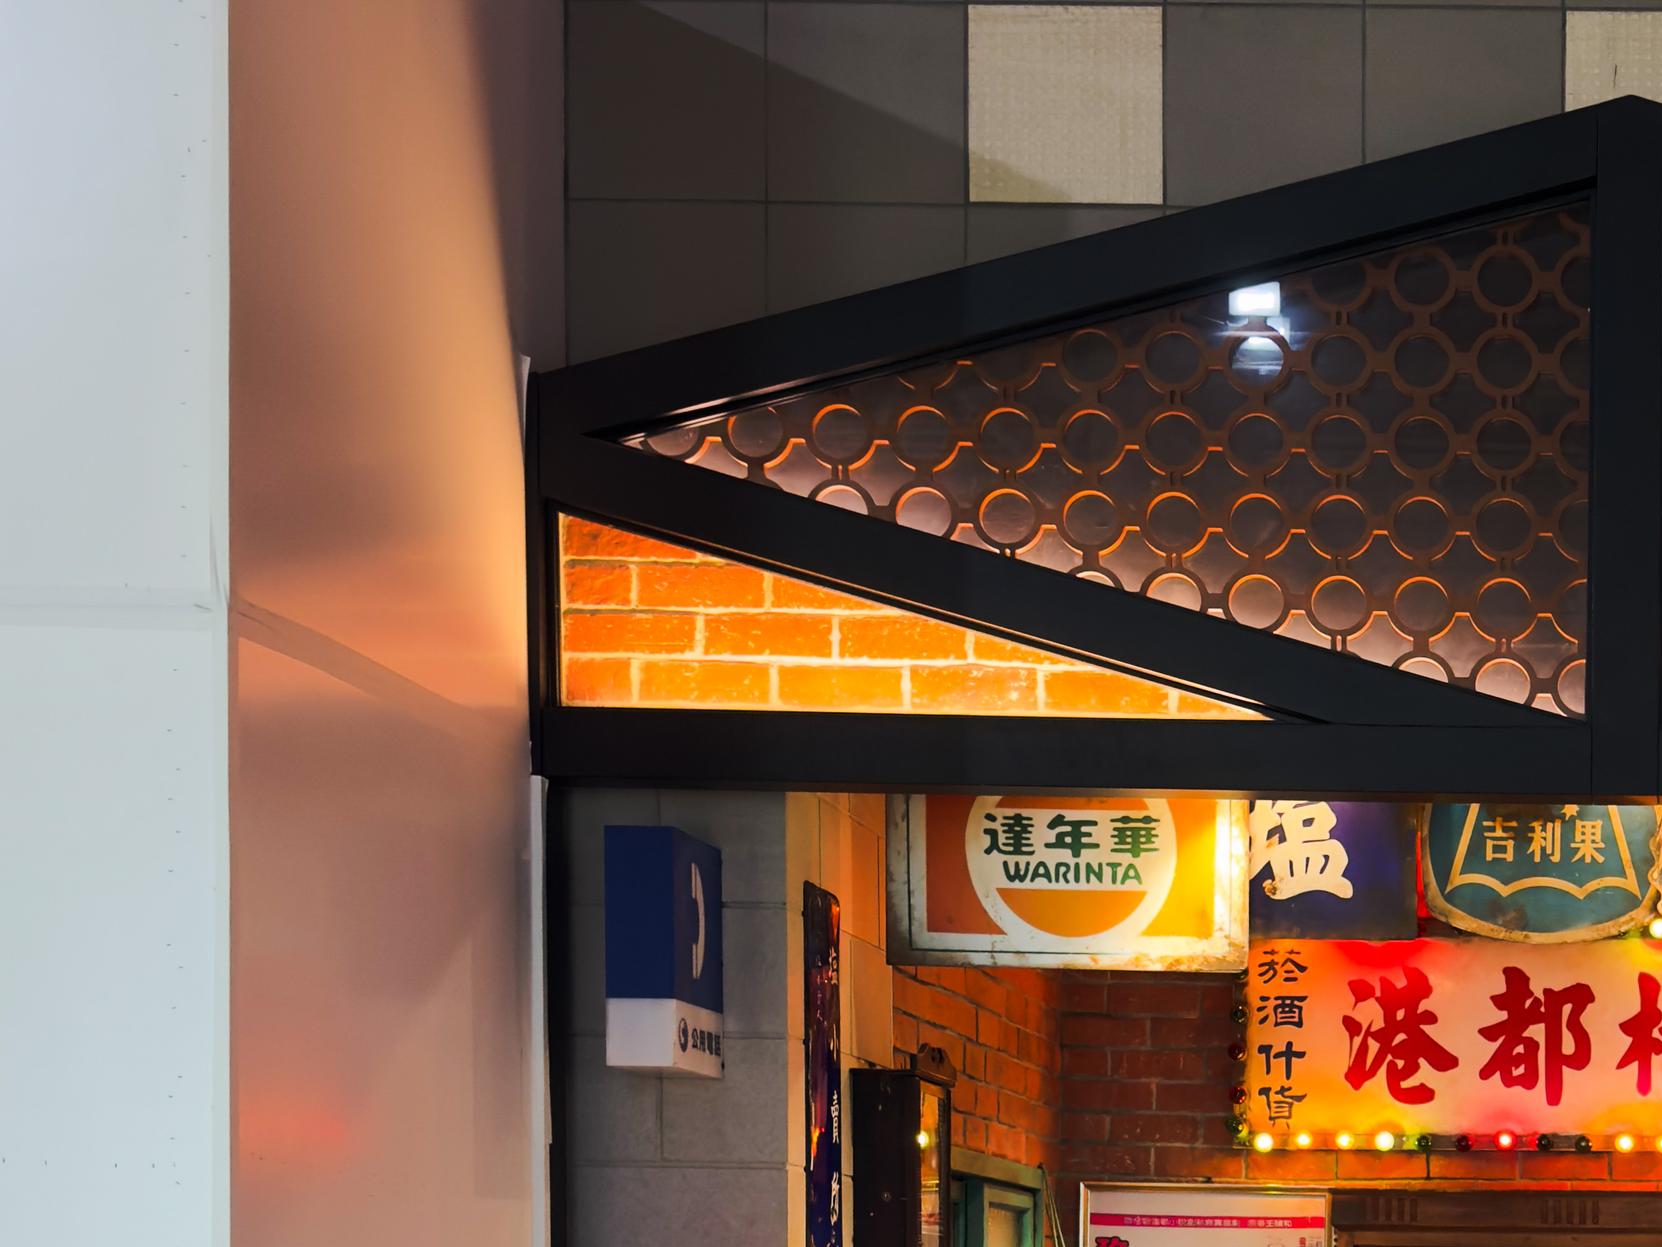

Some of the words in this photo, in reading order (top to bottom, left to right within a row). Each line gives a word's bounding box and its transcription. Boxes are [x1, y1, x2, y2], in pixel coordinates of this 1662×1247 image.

[1482, 817, 1606, 864] 吉利果
[1002, 861, 1143, 885] WARINTA
